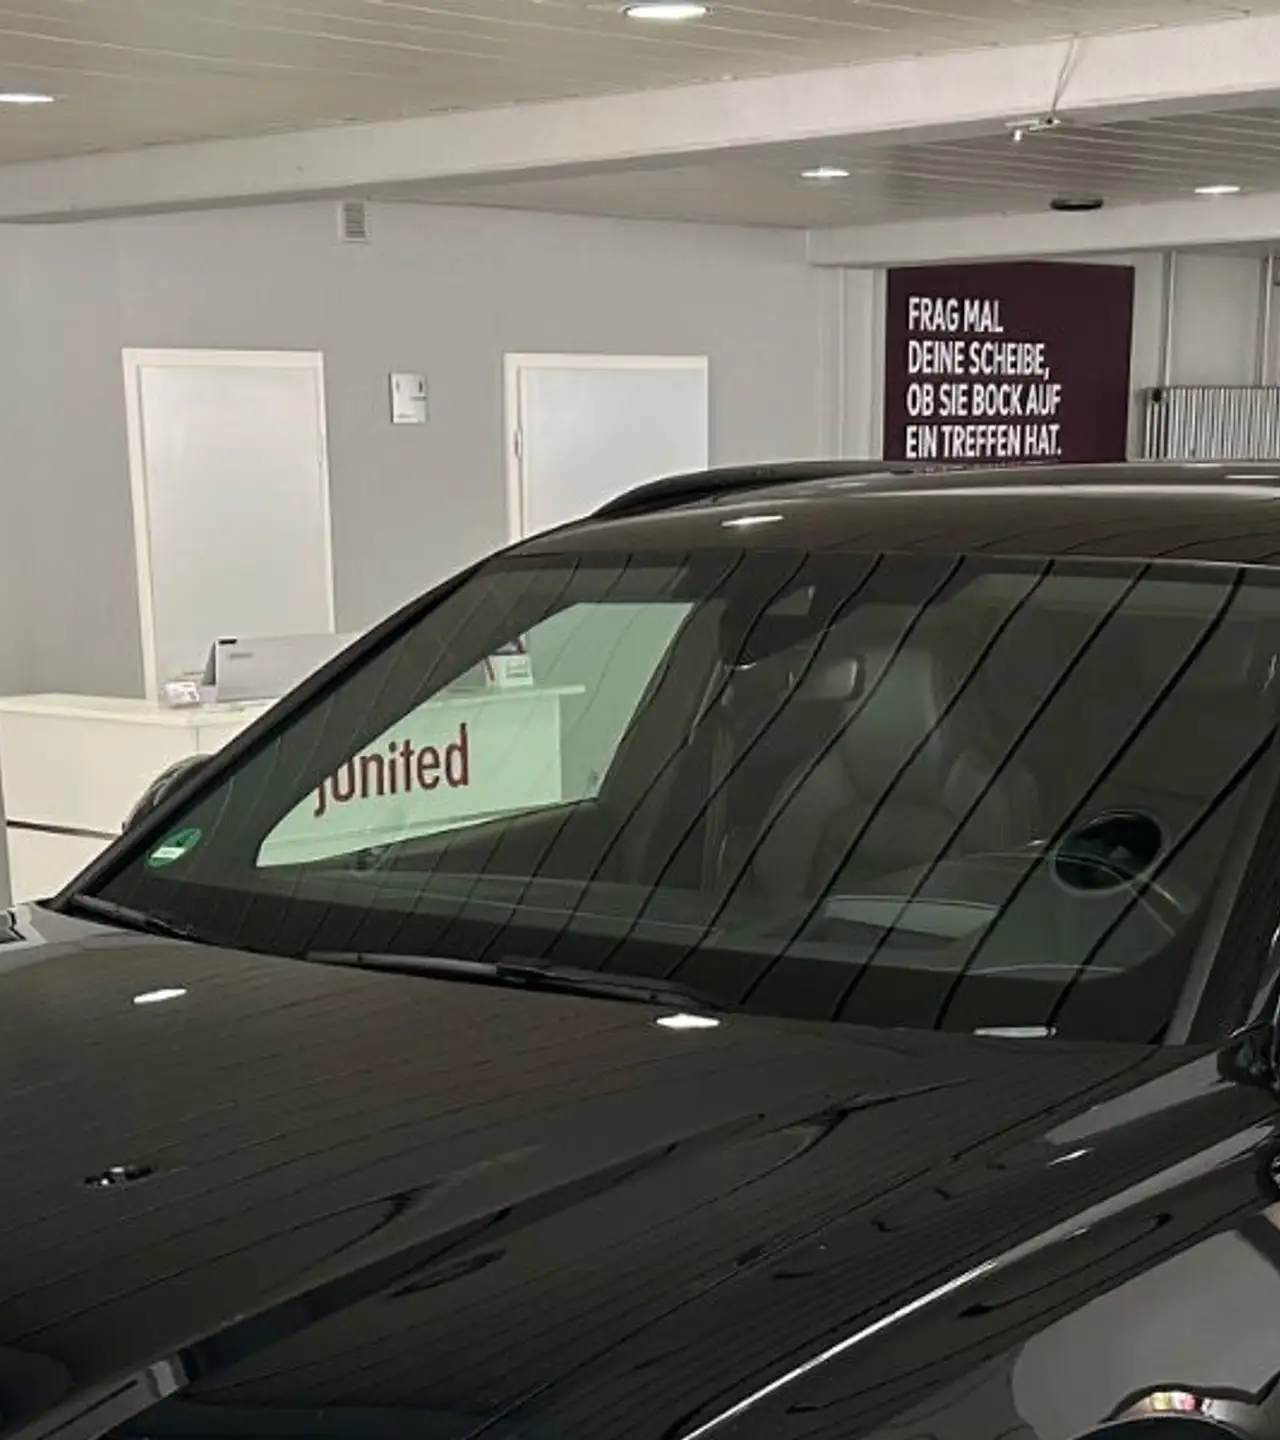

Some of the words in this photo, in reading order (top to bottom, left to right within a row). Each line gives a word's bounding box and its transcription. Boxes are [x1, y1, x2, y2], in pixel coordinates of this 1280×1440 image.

[908, 296, 960, 332] FRAG
[964, 299, 1004, 333] MAL
[908, 340, 965, 374] DEINE
[969, 341, 1050, 380] SCHEIBE,
[906, 383, 934, 416] OB
[939, 383, 968, 416] SIE
[972, 384, 1023, 416] BOCK
[1026, 384, 1062, 416] AUF
[906, 425, 937, 459] EIN
[941, 425, 1021, 458] TREFFEN
[1024, 424, 1062, 456] HAT.
